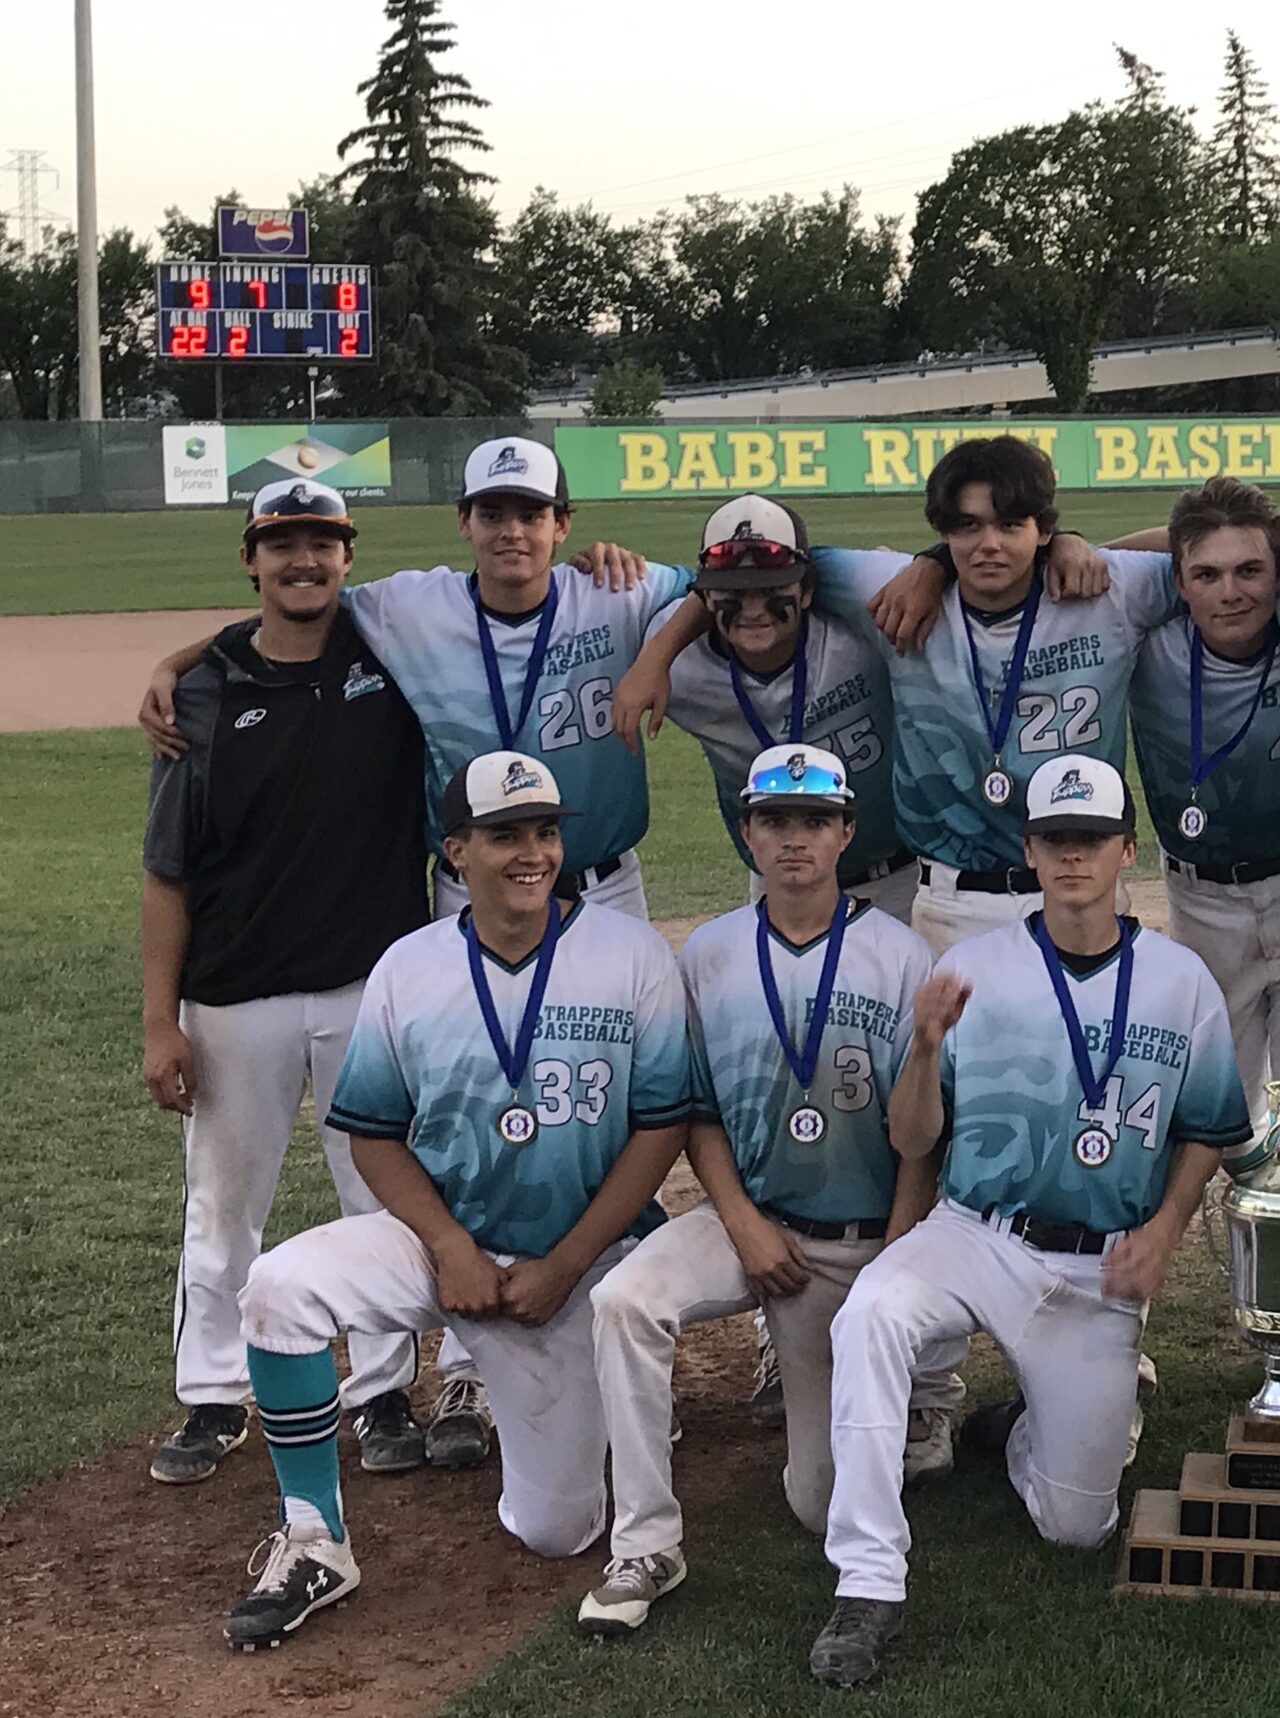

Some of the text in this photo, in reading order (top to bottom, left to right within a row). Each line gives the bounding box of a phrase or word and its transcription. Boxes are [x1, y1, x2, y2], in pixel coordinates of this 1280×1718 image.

[233, 210, 294, 226] PEPSI
[169, 266, 211, 282] HOME
[225, 266, 280, 283] INNING
[312, 267, 367, 284] GUESTS
[189, 279, 210, 309] 9
[248, 281, 267, 308] 7
[337, 281, 358, 310] 8
[224, 312, 251, 328] BALL
[273, 312, 314, 329] STRIKE
[337, 313, 360, 329] OUT
[171, 326, 208, 356] 22
[229, 326, 248, 356] 2
[340, 328, 358, 356] 2
[173, 466, 219, 478] Bennett
[618, 430, 828, 492] BABE
[862, 427, 1060, 491] RU
[181, 479, 213, 492] Jones
[1028, 634, 1101, 664] RAPPERS
[805, 674, 865, 715] APPERS
[538, 676, 616, 752] 26
[780, 687, 872, 735] SEBALL
[1016, 684, 1102, 754] 22
[808, 713, 884, 775] 5
[544, 1005, 635, 1027] TRAPPERS
[832, 990, 899, 1025] RAPPERS
[1103, 1018, 1189, 1051] TAPPERS
[532, 1058, 613, 1128] 33
[832, 1044, 873, 1113] 3
[1077, 1074, 1162, 1151] 44
